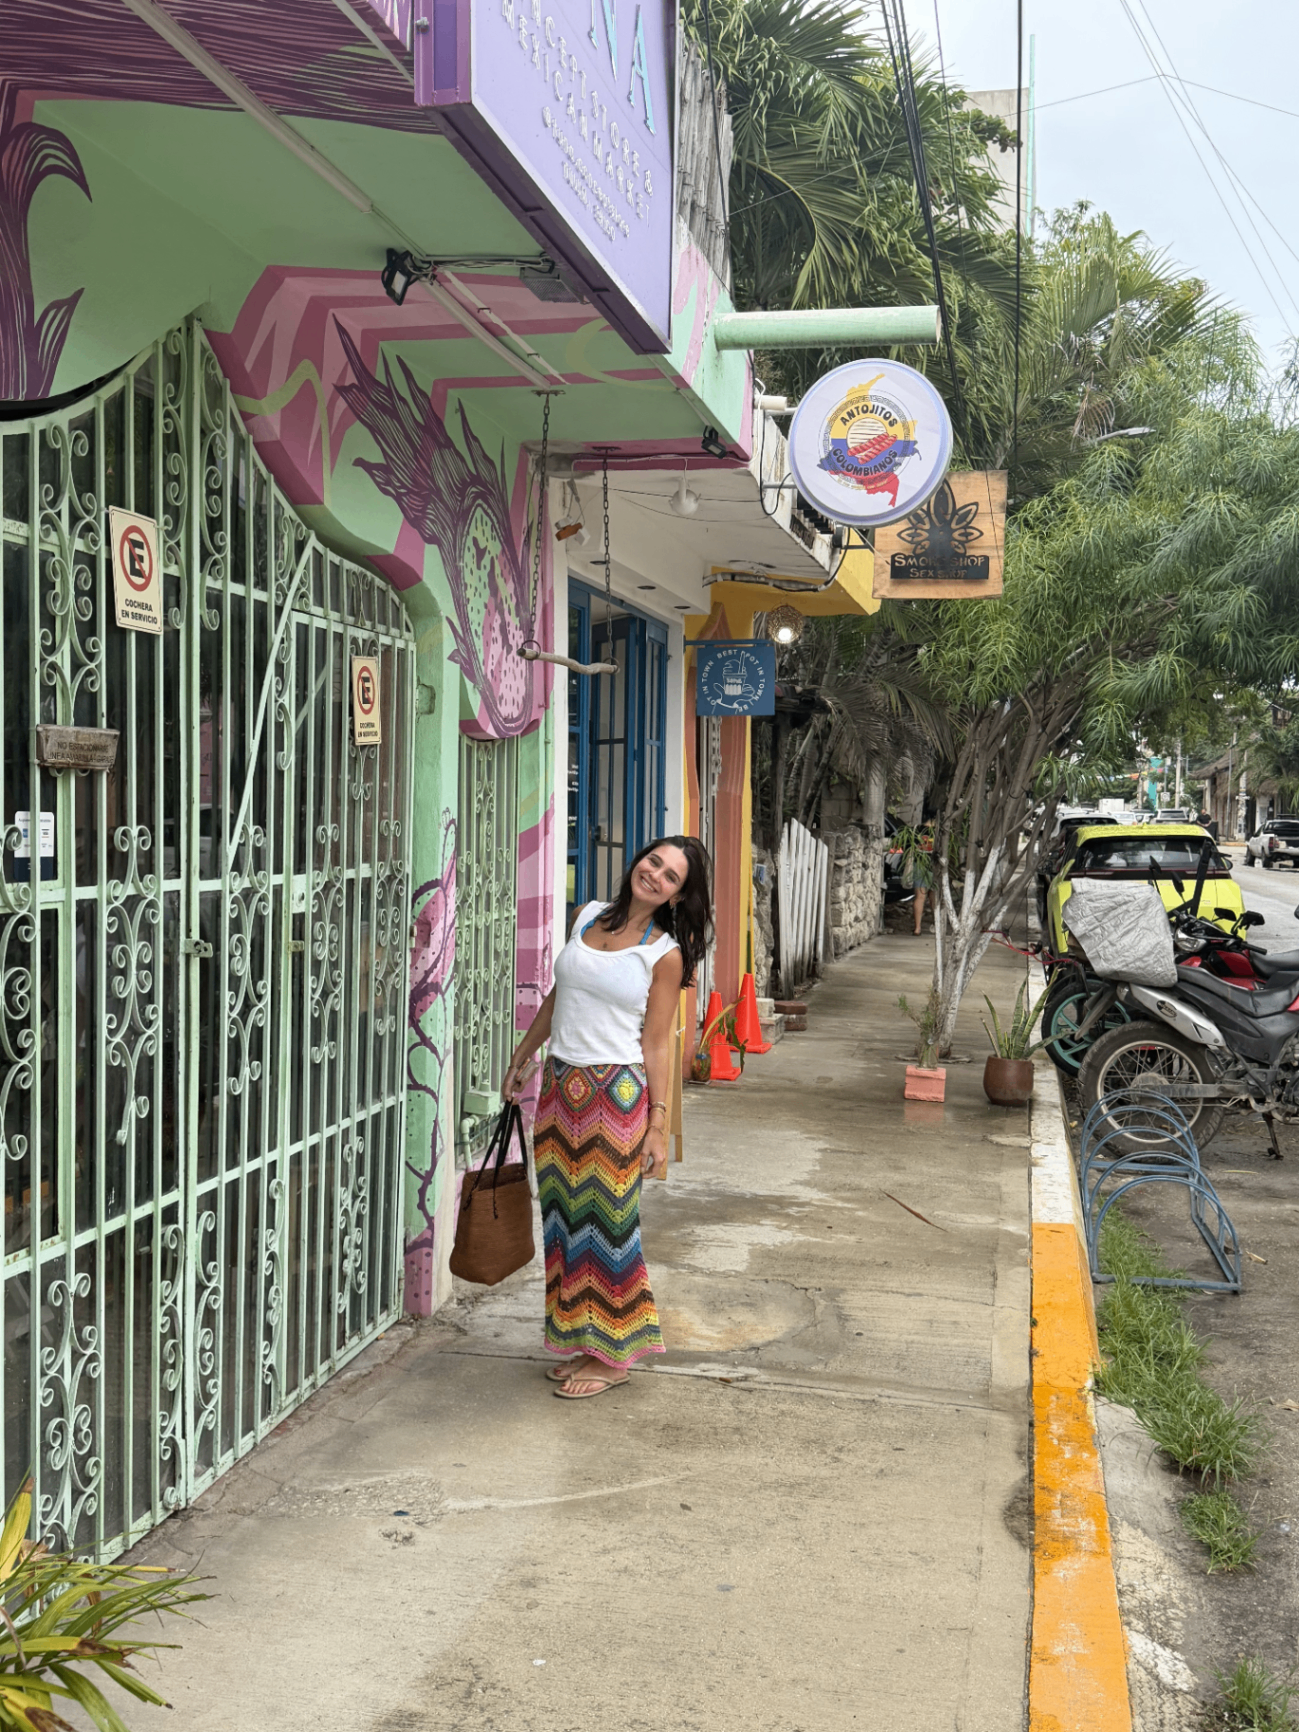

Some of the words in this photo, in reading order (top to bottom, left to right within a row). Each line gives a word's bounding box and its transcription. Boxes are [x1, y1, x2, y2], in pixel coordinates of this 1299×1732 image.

[501, 0, 588, 142] MEXICAN
[592, 130, 650, 227] MARKET
[591, 86, 640, 178] STORE
[643, 168, 654, 197] &
[839, 403, 898, 428] ANTOJITOS
[832, 448, 898, 477] COLOMBIANOS
[129, 538, 146, 579] E
[950, 556, 985, 567] SHOP
[909, 567, 935, 578] SEX
[124, 598, 154, 613] COCHERA
[121, 609, 130, 619] EN
[131, 611, 158, 625] SERVICIO
[717, 649, 738, 659] BEST
[702, 660, 714, 683] TOWN
[757, 666, 765, 676] IN
[753, 678, 766, 701] TOWN
[57, 741, 67, 750] NO
